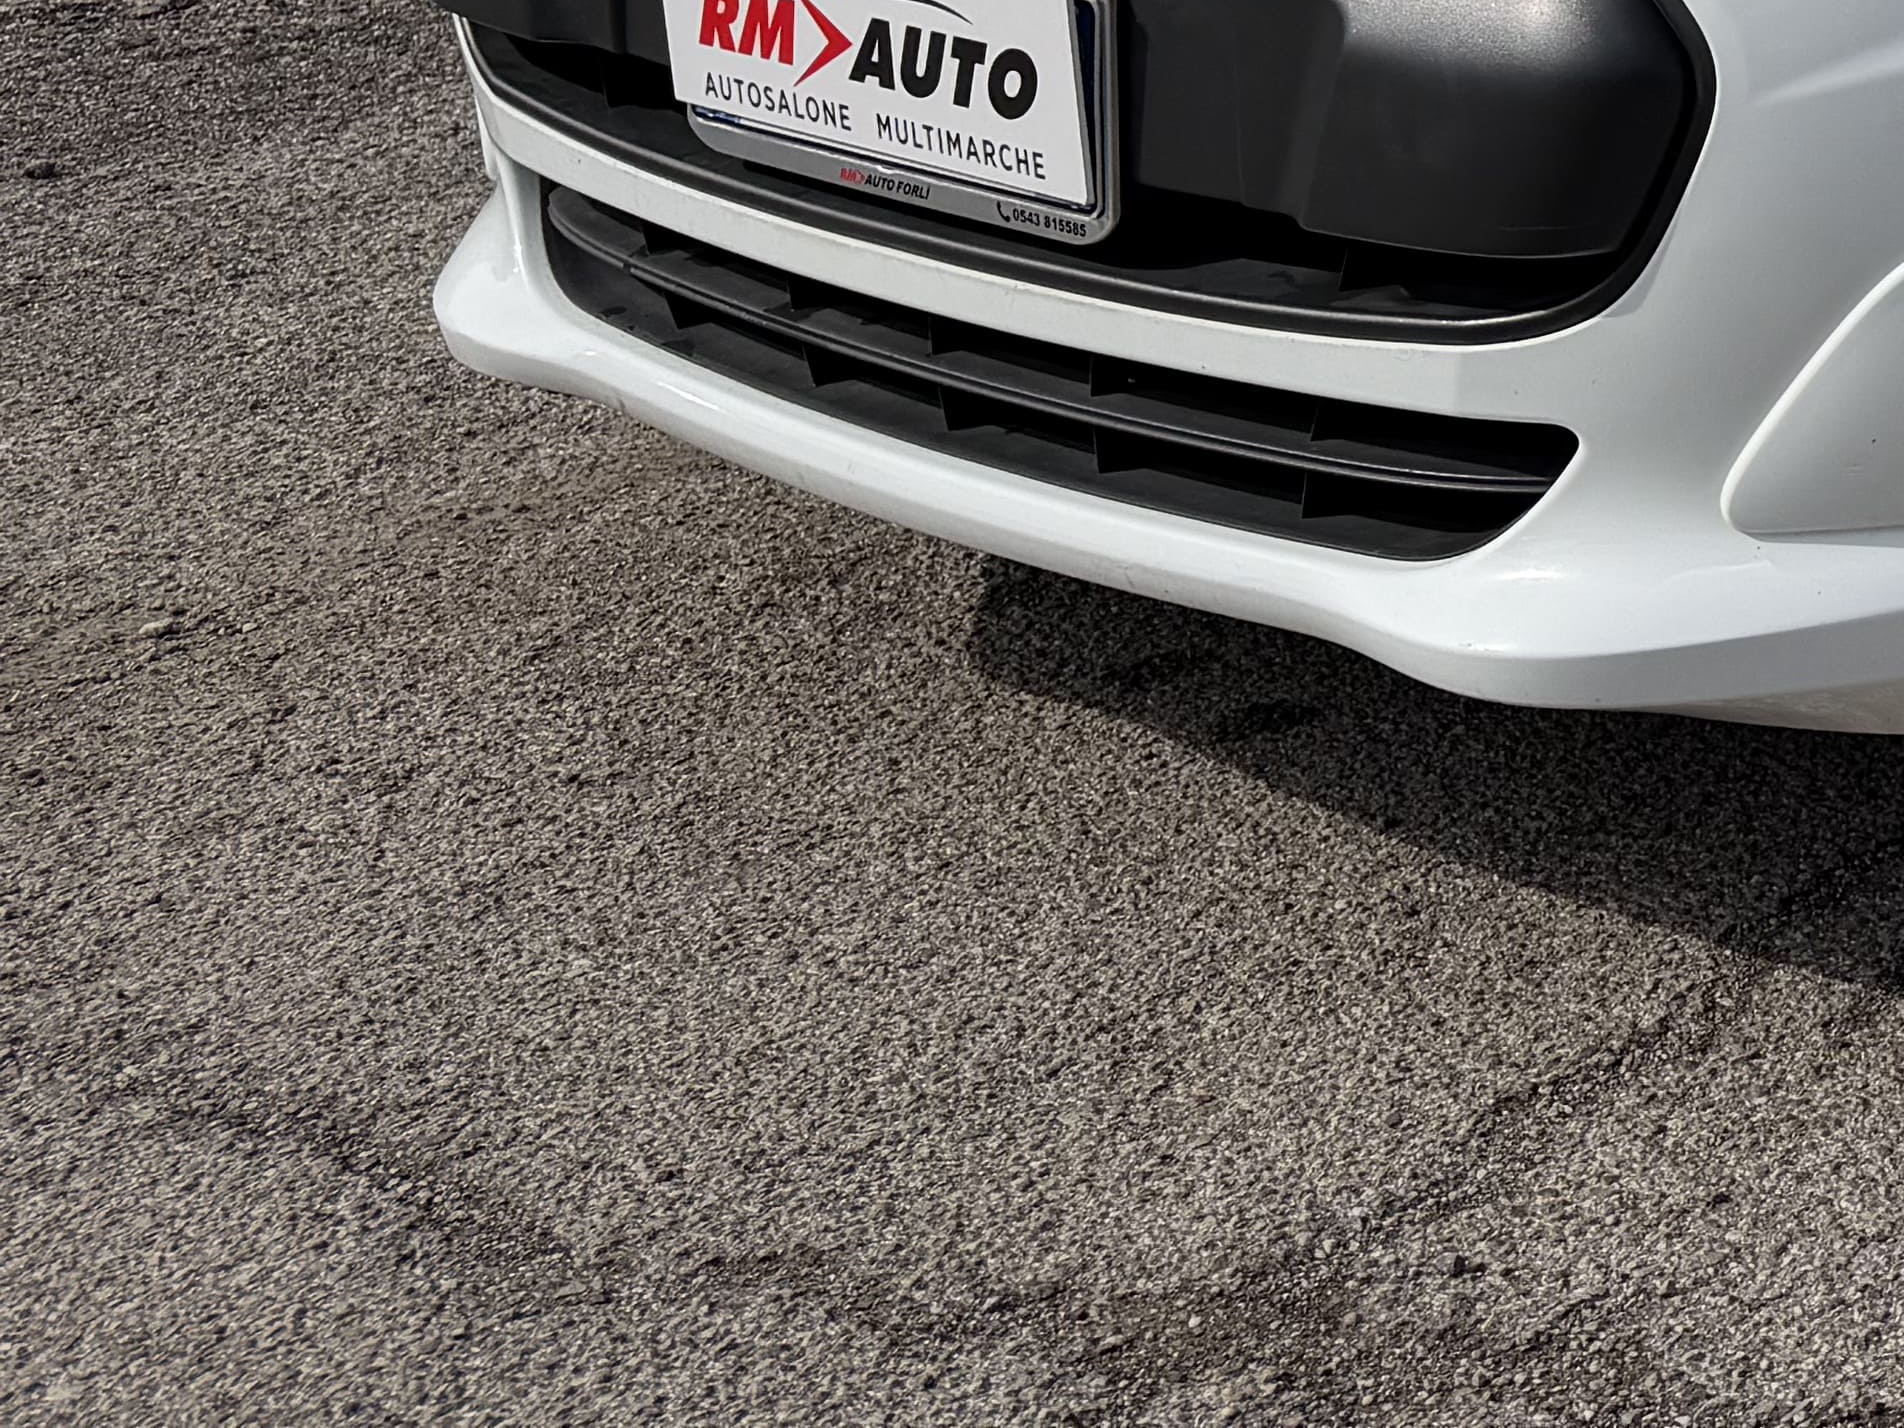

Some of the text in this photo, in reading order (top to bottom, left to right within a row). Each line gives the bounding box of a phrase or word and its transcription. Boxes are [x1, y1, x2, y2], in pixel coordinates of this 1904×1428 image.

[848, 17, 1038, 120] AUTO
[705, 71, 1046, 180] AUTOSALONE MULTIMARCHE
[864, 174, 895, 191] AUTO
[1012, 208, 1087, 238] 0543 815585
